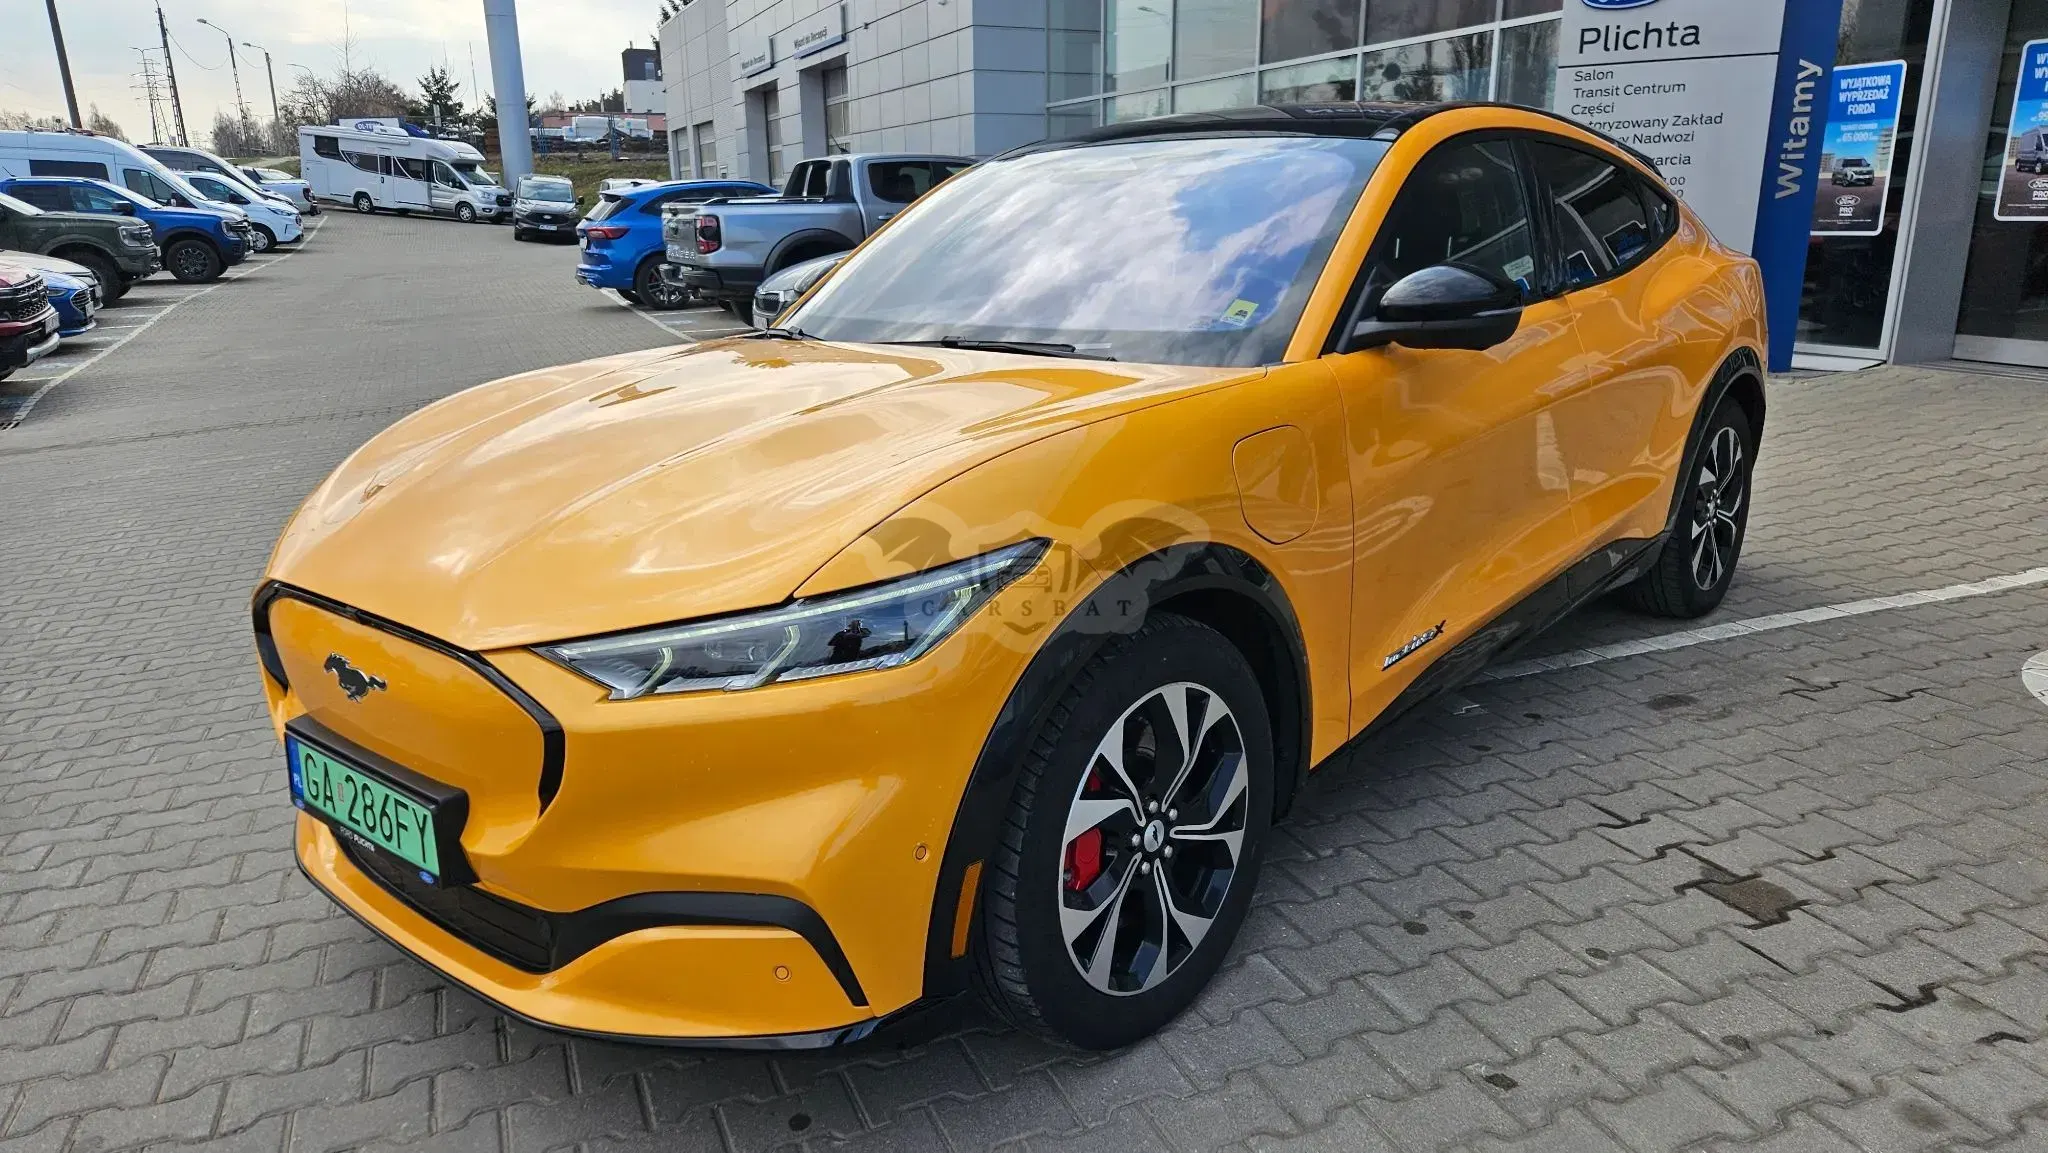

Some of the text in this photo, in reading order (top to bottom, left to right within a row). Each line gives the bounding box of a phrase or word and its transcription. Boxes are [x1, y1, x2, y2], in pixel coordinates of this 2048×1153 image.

[1578, 21, 1700, 54] Plichta
[1574, 70, 1614, 82] Salon
[1840, 75, 1891, 91] WYJĄTKOWA
[1573, 82, 1687, 99] Transit Centrum
[1839, 86, 1890, 103] WYPRZEDAŻ
[1571, 102, 1615, 118] Części
[1847, 102, 1876, 115] FORDA
[1588, 112, 1724, 132] toryzowany Zakład
[1775, 59, 1823, 199] Witamy
[1632, 131, 1695, 145] Nadwozi
[304, 752, 428, 864] GA 286FY
